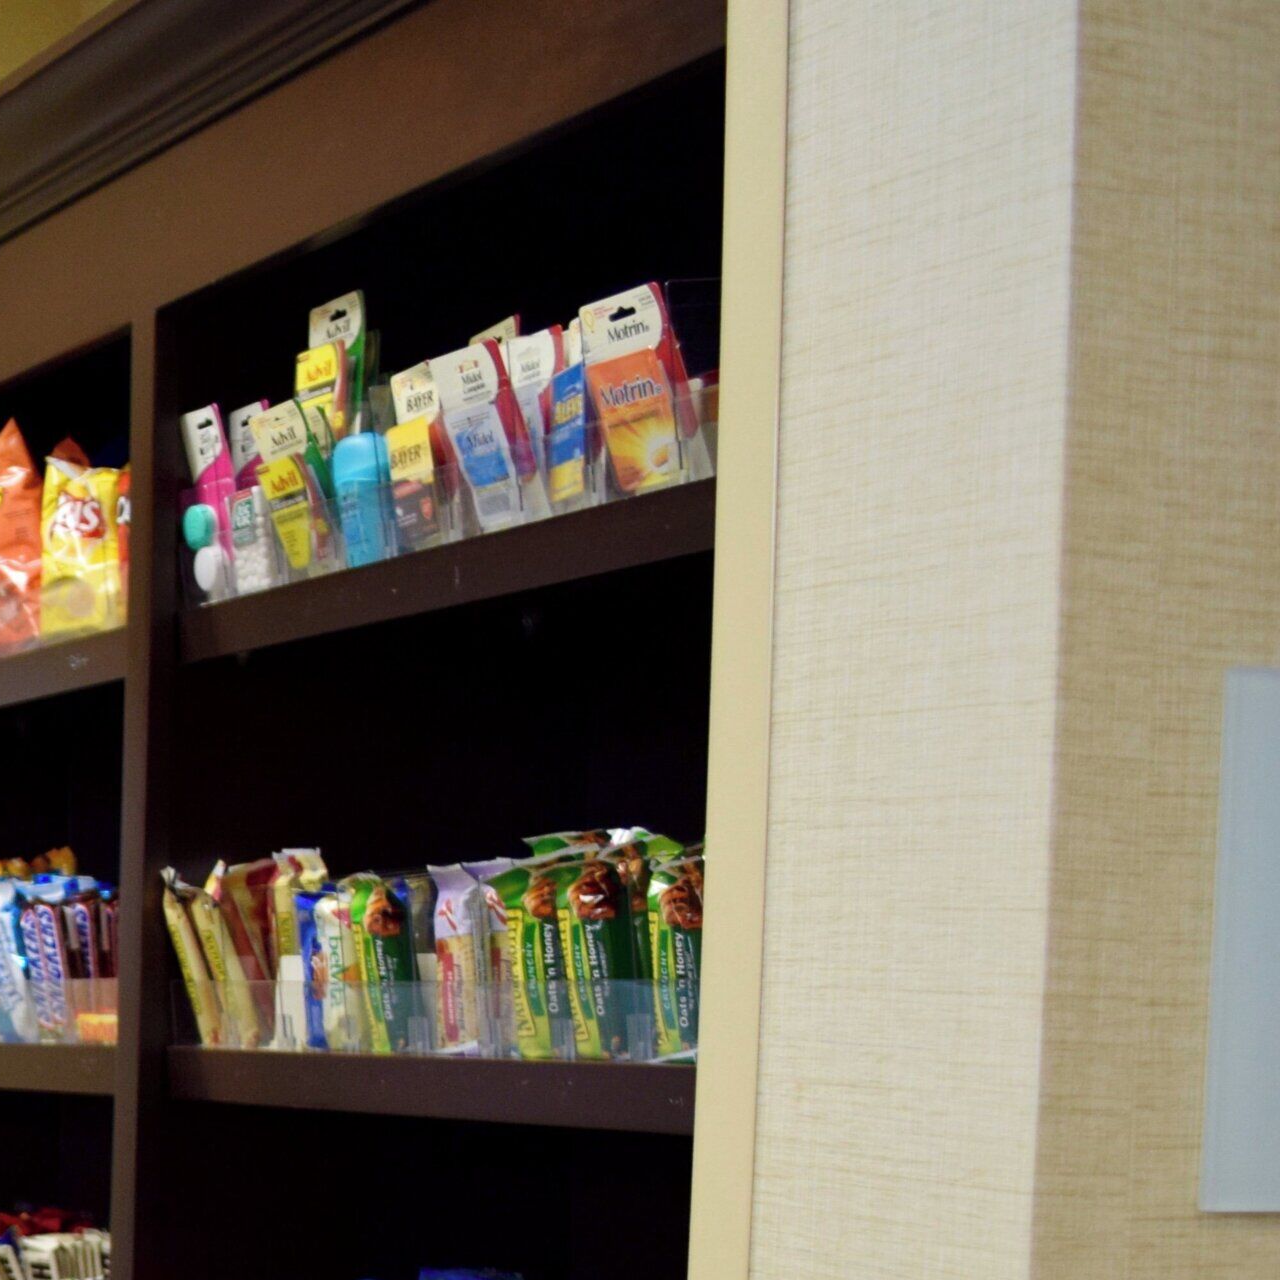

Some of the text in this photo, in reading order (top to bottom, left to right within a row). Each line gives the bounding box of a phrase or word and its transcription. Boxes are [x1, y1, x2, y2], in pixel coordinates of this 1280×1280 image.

[606, 319, 645, 343] Motrin
[600, 376, 655, 408] Motrin
[543, 922, 556, 964] Honey
[584, 924, 597, 965] Honey
[673, 931, 686, 976] Honey
[547, 981, 559, 1013] Oats
[593, 984, 605, 1016] Oats
[677, 996, 689, 1028] Oats
